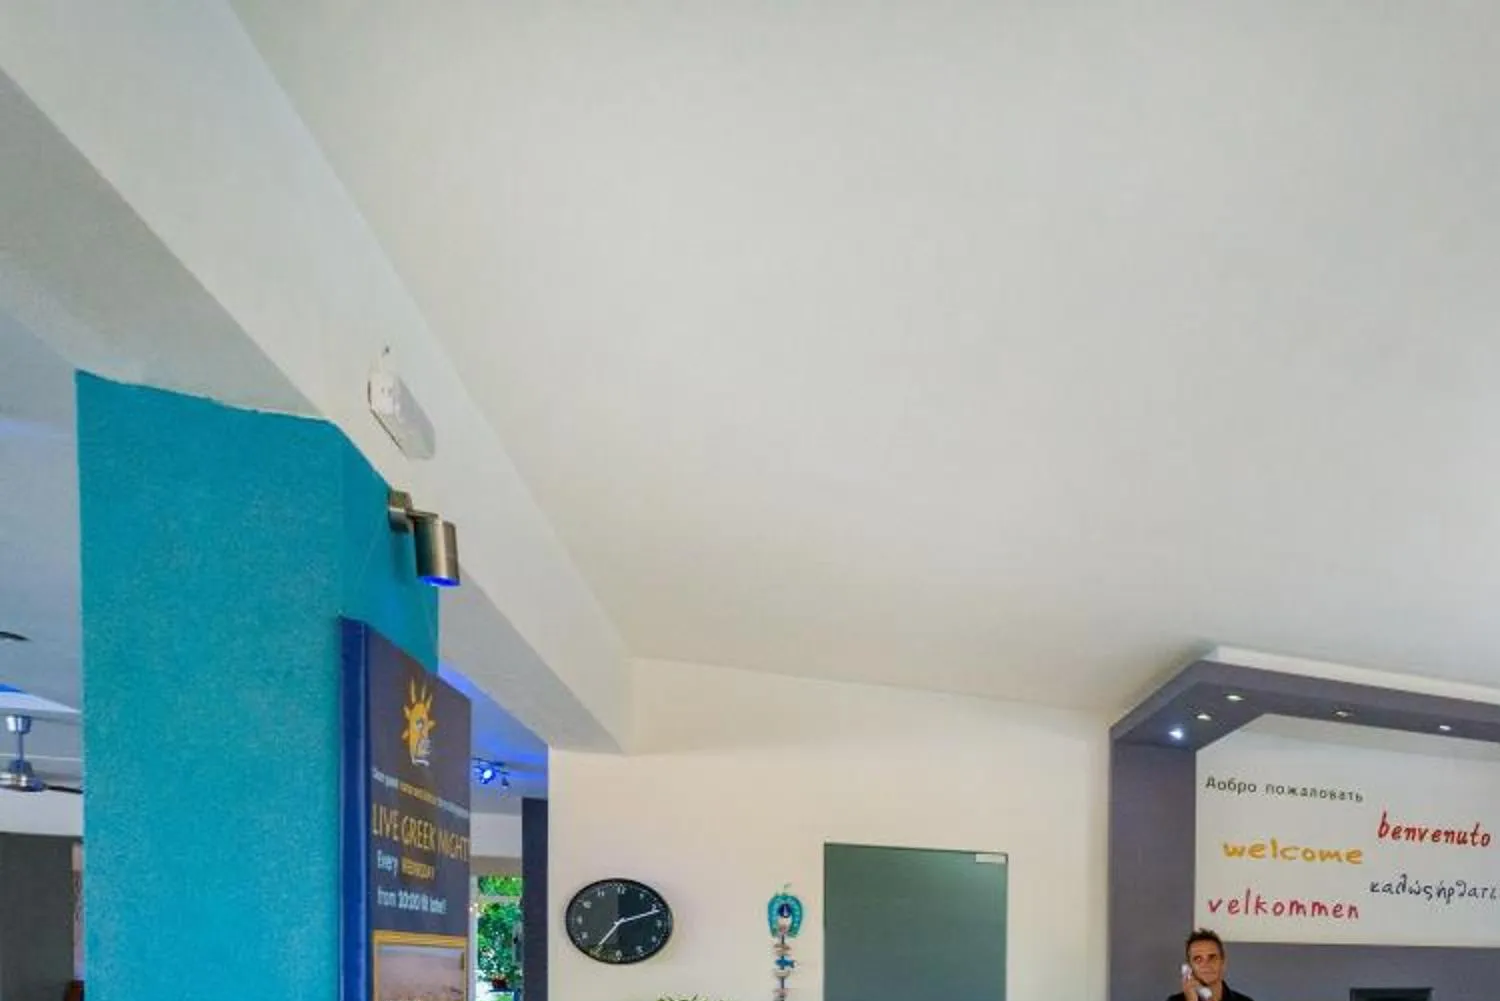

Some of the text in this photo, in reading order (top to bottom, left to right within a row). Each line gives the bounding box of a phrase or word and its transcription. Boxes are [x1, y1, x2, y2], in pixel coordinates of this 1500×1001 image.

[1205, 776, 1364, 802] Добро пожаловать
[372, 802, 400, 841] LIVE
[401, 815, 436, 852] GREEK
[1377, 811, 1491, 847] benvenuto
[1222, 837, 1363, 865] welcome
[1208, 887, 1360, 919] velkommen
